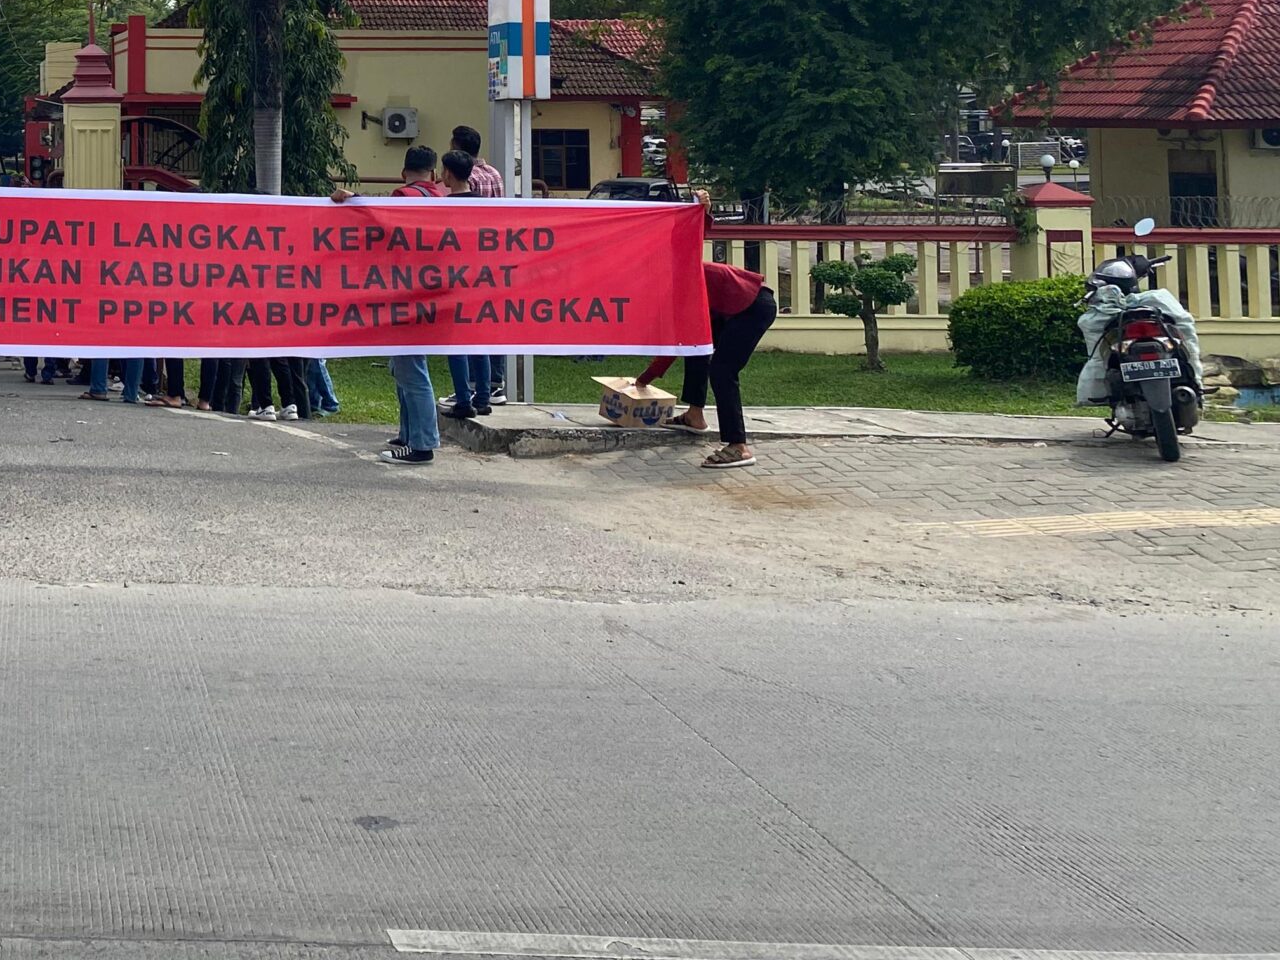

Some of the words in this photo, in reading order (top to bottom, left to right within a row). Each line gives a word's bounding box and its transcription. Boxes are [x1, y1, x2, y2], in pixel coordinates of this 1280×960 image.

[490, 31, 501, 45] ATM
[113, 222, 294, 255] LANGKAT,
[313, 225, 462, 252] KEPALA
[478, 227, 554, 252] BKD
[100, 260, 322, 289] KABUPATEN
[340, 264, 518, 292] LANGKAT
[98, 299, 194, 325] PPPK
[212, 300, 437, 328] KABUPATEN
[453, 297, 630, 324] LANGKAT
